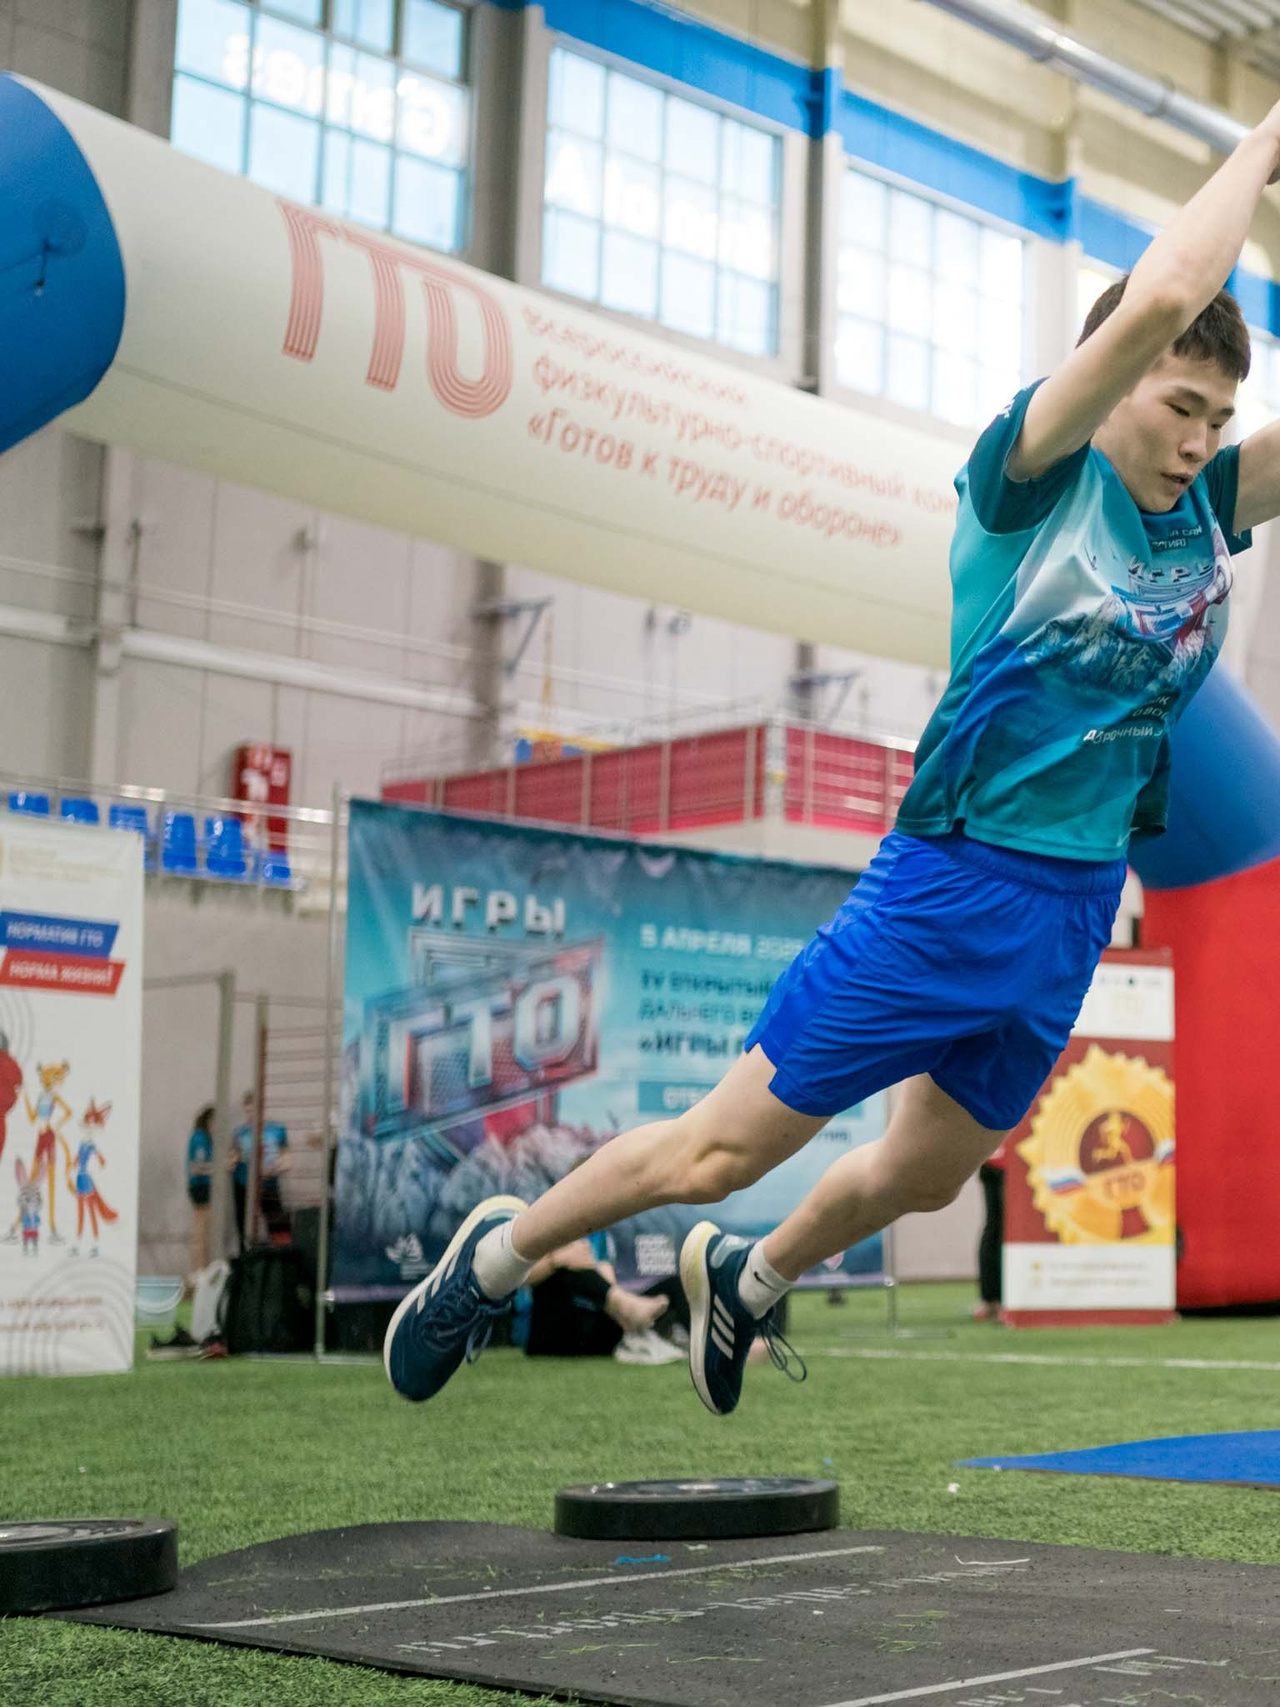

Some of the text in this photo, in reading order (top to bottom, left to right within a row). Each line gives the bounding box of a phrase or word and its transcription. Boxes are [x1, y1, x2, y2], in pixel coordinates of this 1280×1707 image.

[280, 201, 514, 418] ГТО
[528, 407, 635, 470] «Готов
[642, 452, 660, 477] к
[669, 456, 748, 511] труду
[752, 485, 772, 510] и
[411, 882, 566, 938] ИГРЫ
[661, 926, 752, 956] АПРЕЛЯ
[388, 976, 583, 1112] ГТО
